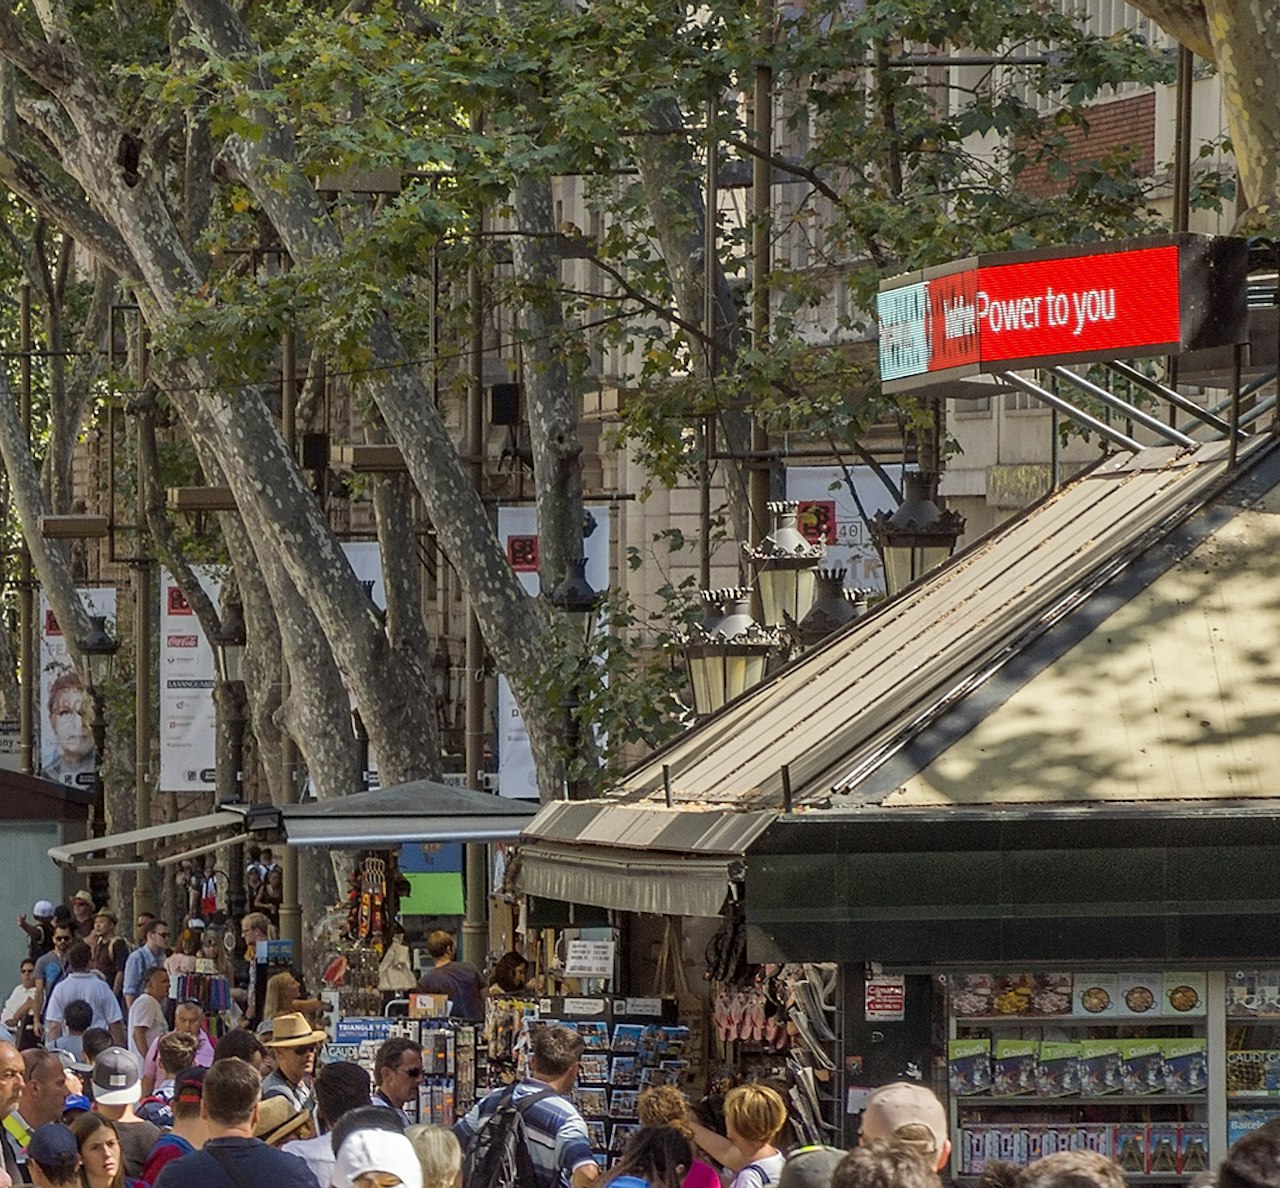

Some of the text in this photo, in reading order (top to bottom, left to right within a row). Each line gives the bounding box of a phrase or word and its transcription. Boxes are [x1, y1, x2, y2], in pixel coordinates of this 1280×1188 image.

[977, 291, 1043, 333] Power
[1045, 287, 1069, 327] to
[1073, 288, 1116, 336] you
[338, 1023, 374, 1031] TRIANGLE
[1231, 1120, 1264, 1130] Barcel
